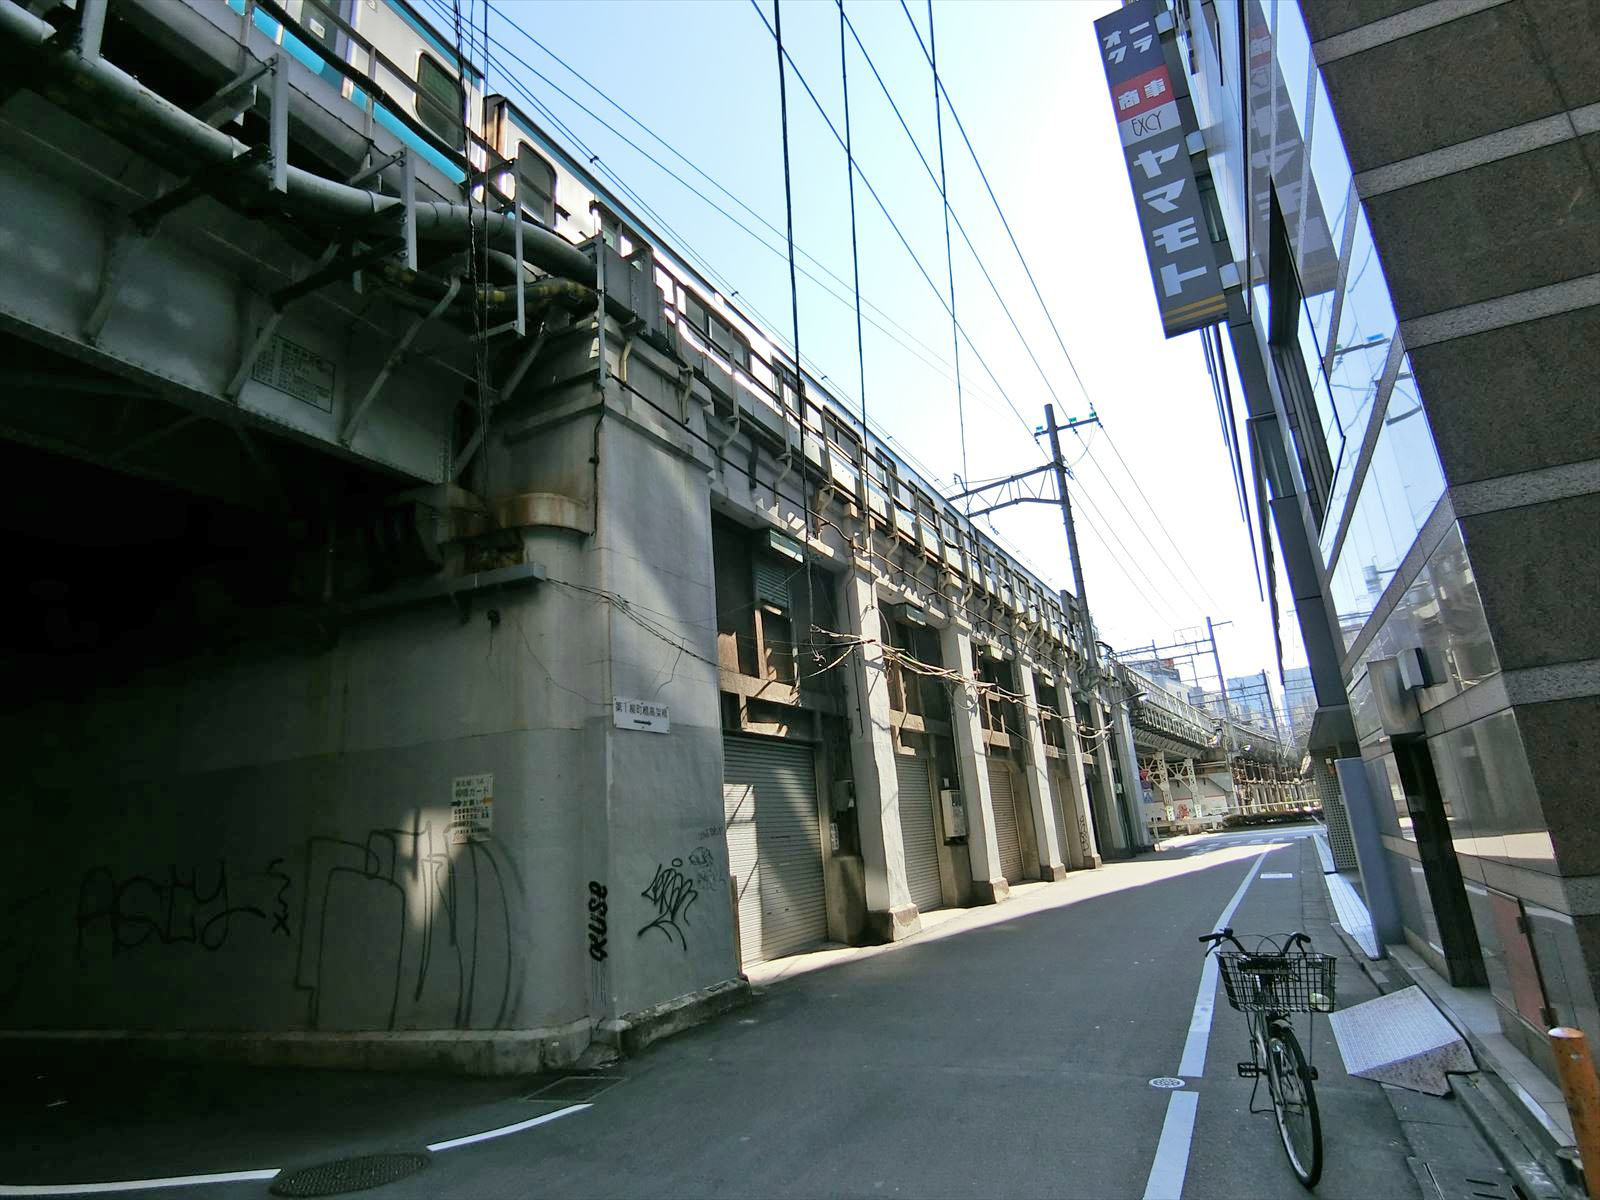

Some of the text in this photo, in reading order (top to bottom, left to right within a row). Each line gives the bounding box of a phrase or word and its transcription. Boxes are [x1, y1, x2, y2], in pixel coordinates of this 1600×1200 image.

[1118, 78, 1166, 110] 商事
[1131, 110, 1162, 137] EXCY
[1133, 143, 1208, 297] ヤマモト
